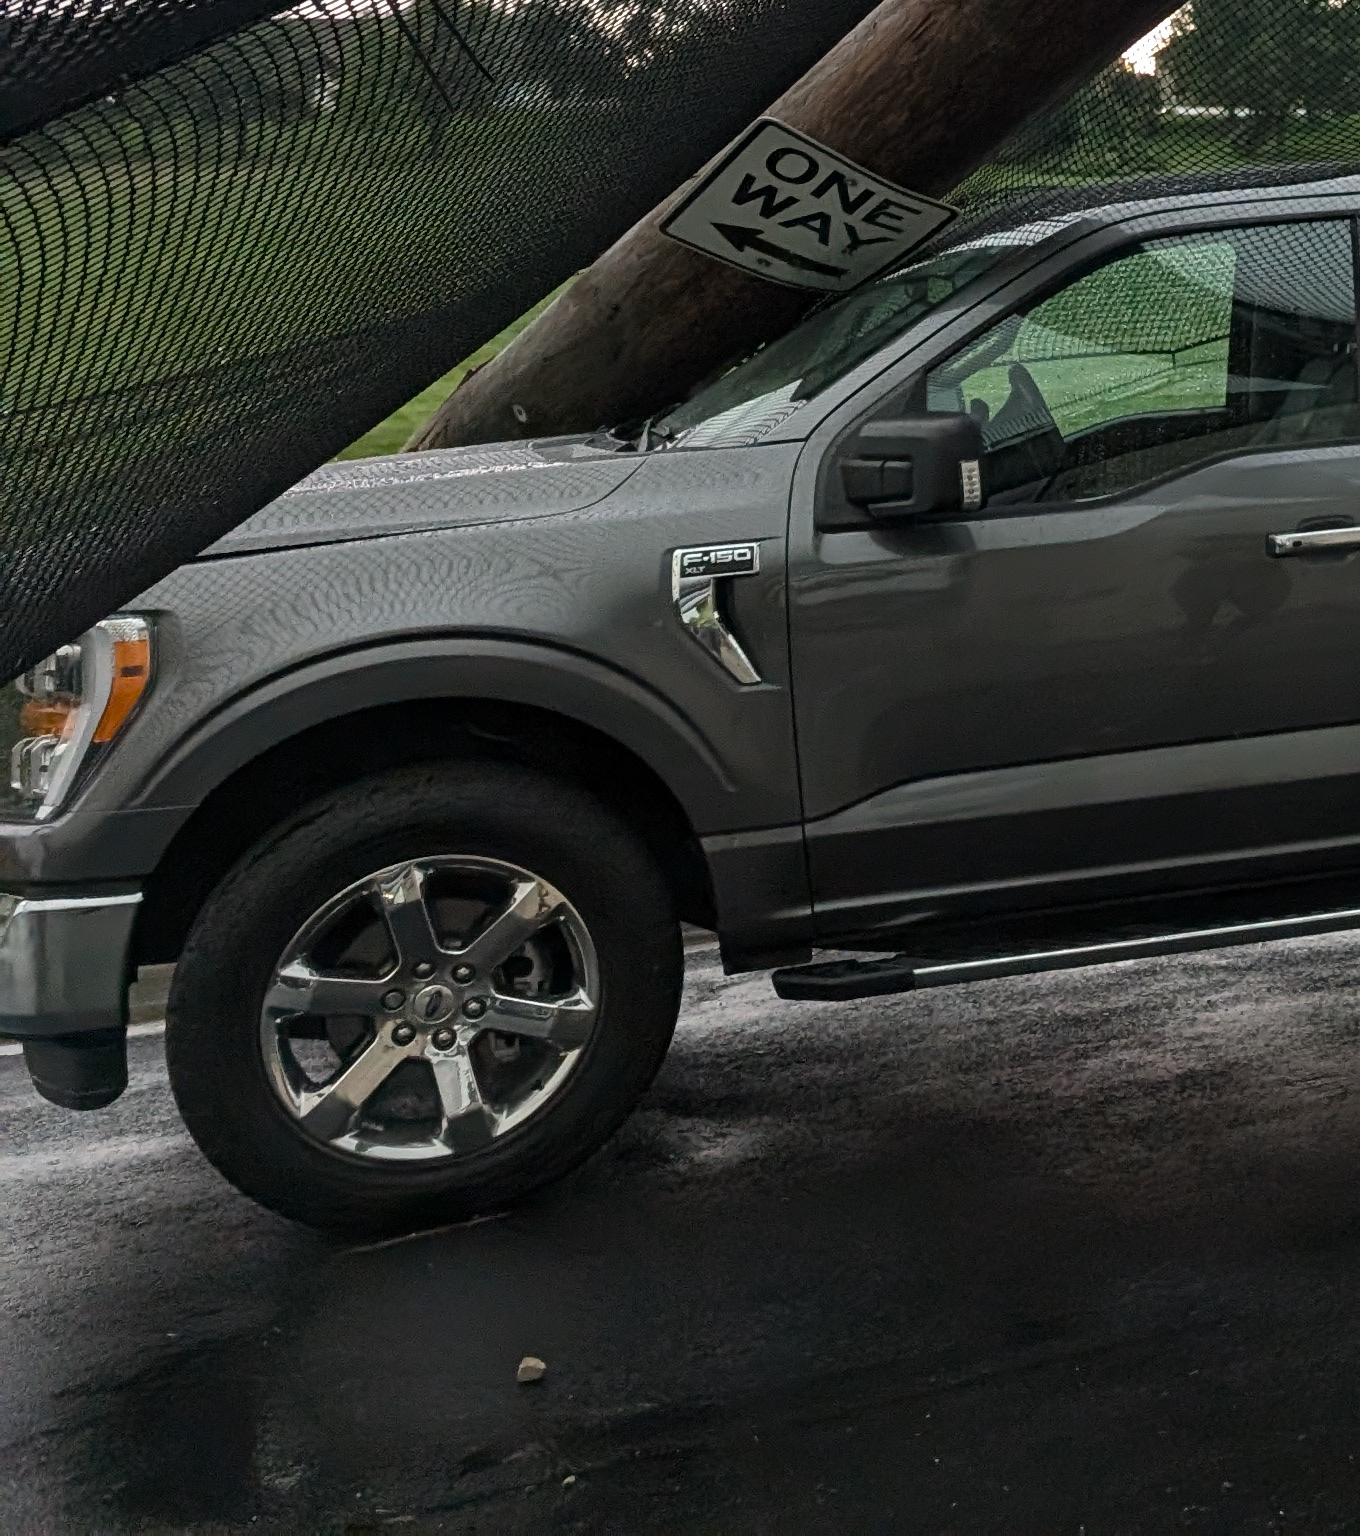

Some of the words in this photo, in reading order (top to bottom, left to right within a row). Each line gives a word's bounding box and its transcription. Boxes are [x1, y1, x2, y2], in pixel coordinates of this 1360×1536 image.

[731, 172, 897, 256] WAY
[765, 147, 922, 234] ONE
[682, 548, 752, 567] F-150
[685, 565, 706, 576] XLT
